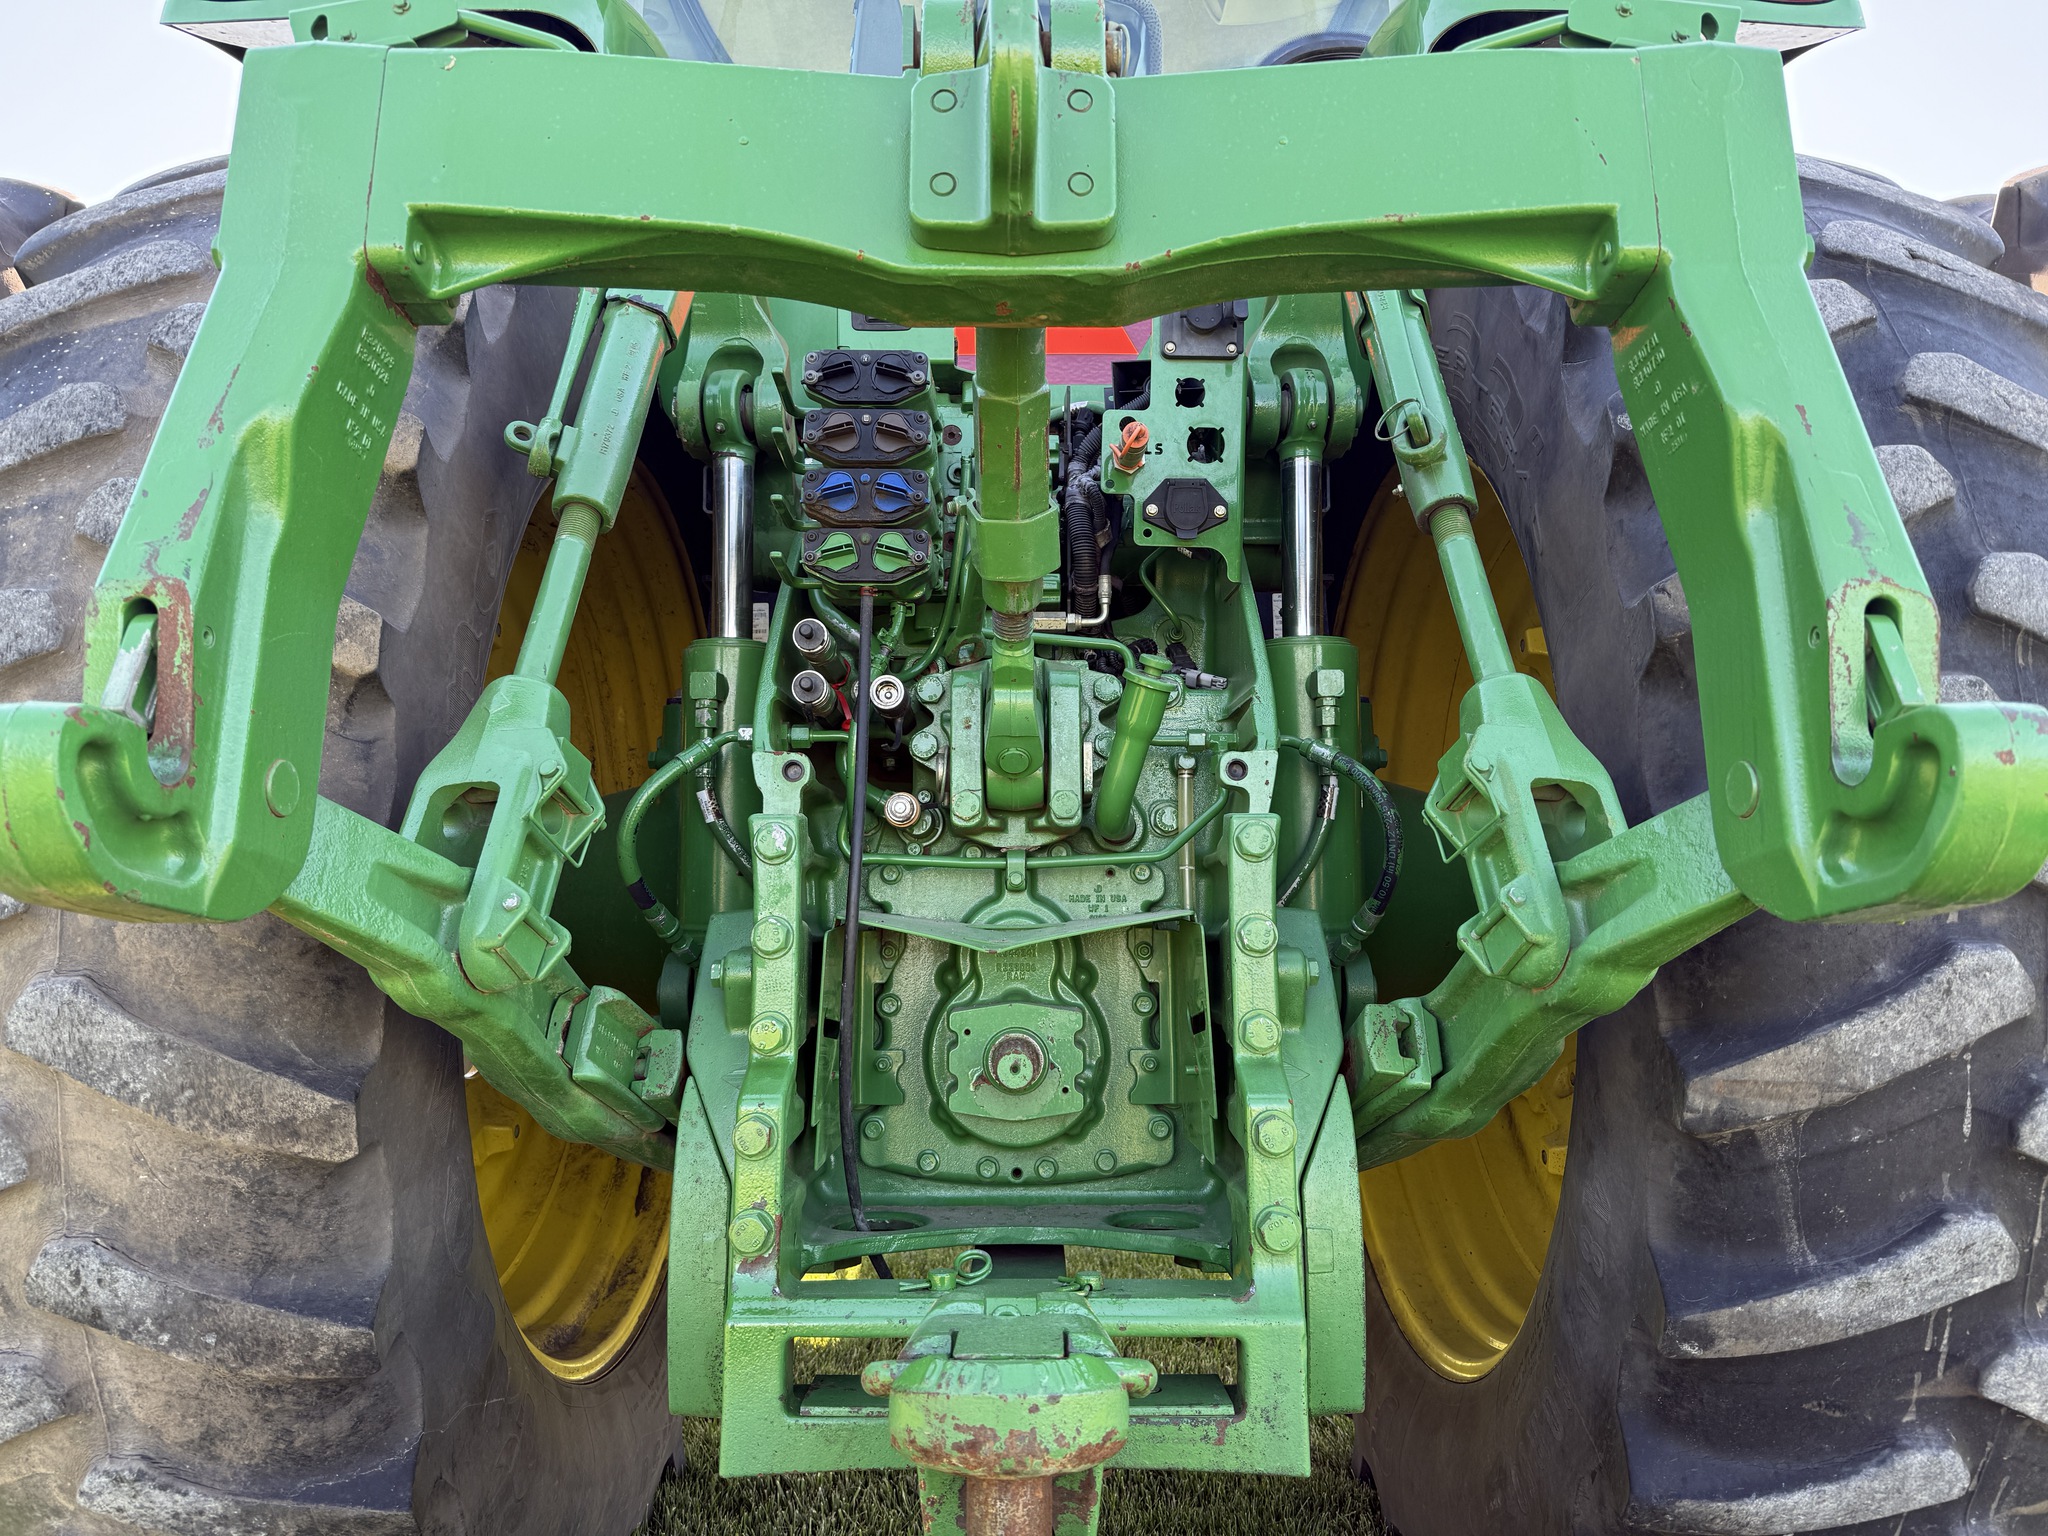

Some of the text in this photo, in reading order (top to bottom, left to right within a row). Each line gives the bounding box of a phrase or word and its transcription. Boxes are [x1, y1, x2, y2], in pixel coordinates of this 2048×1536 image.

[1173, 503, 1201, 513] Pollak
[1388, 830, 1396, 859] DN12
[1094, 884, 1103, 894] JD
[1069, 894, 1128, 903] MADE IN USA
